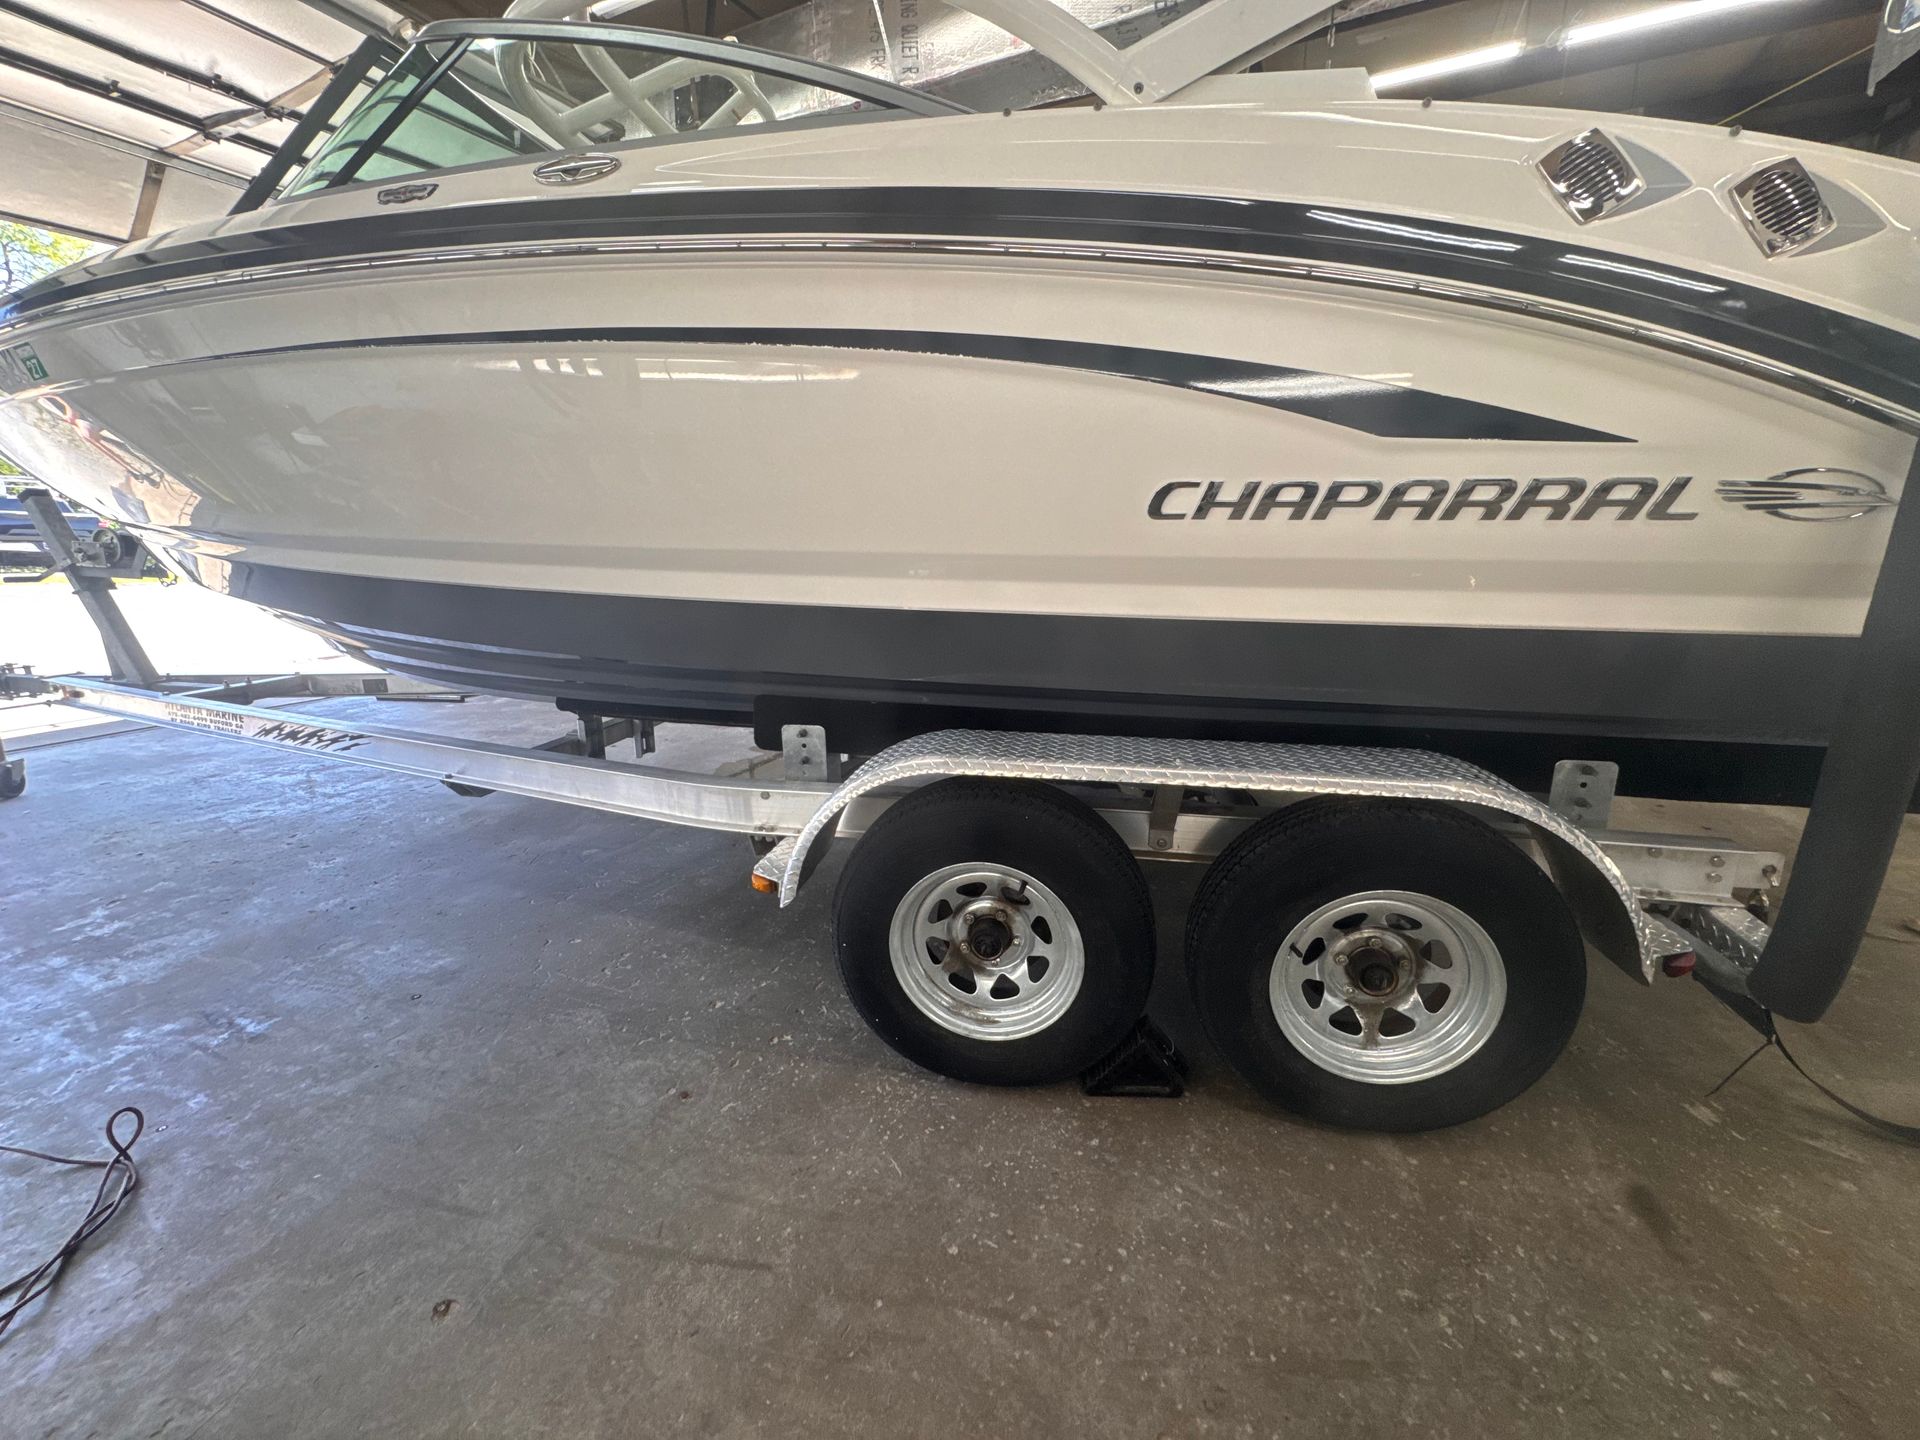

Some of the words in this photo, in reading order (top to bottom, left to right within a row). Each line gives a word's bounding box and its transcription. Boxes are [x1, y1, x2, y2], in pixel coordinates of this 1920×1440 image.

[901, 24, 919, 60] QUIET
[871, 48, 886, 70] FRK
[902, 66, 919, 75] R
[25, 358, 44, 379] 27
[1147, 477, 1699, 521] CHAPARRAL
[206, 708, 245, 724] MARINE
[209, 718, 234, 728] BUFORD
[214, 725, 242, 735] TRAILERS
